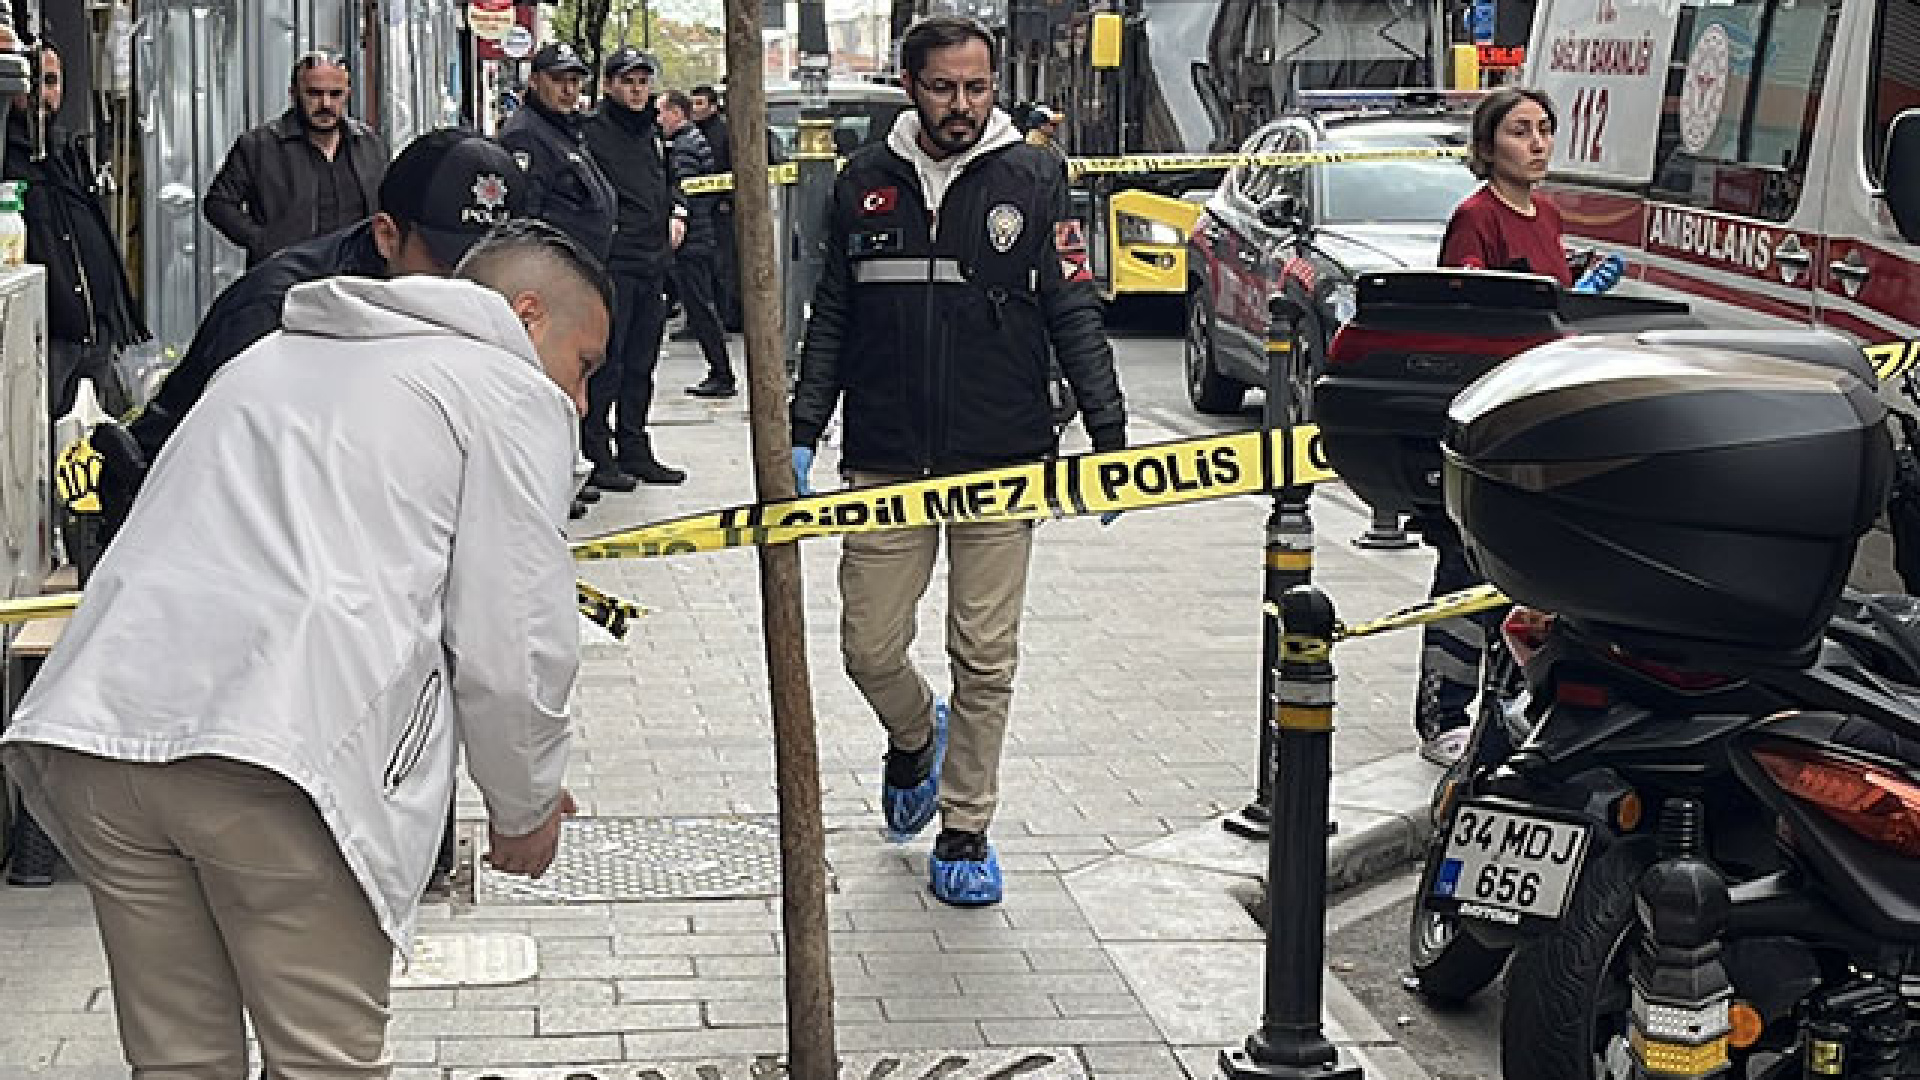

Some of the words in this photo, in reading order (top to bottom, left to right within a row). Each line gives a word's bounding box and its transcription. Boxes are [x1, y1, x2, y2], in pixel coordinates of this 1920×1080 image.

[1568, 87, 1609, 162] 112
[461, 208, 512, 224] POL
[1648, 206, 1771, 271] AMBULANS
[1454, 811, 1496, 852] 34
[1499, 818, 1580, 865] MDJ
[1475, 863, 1541, 907] 656
